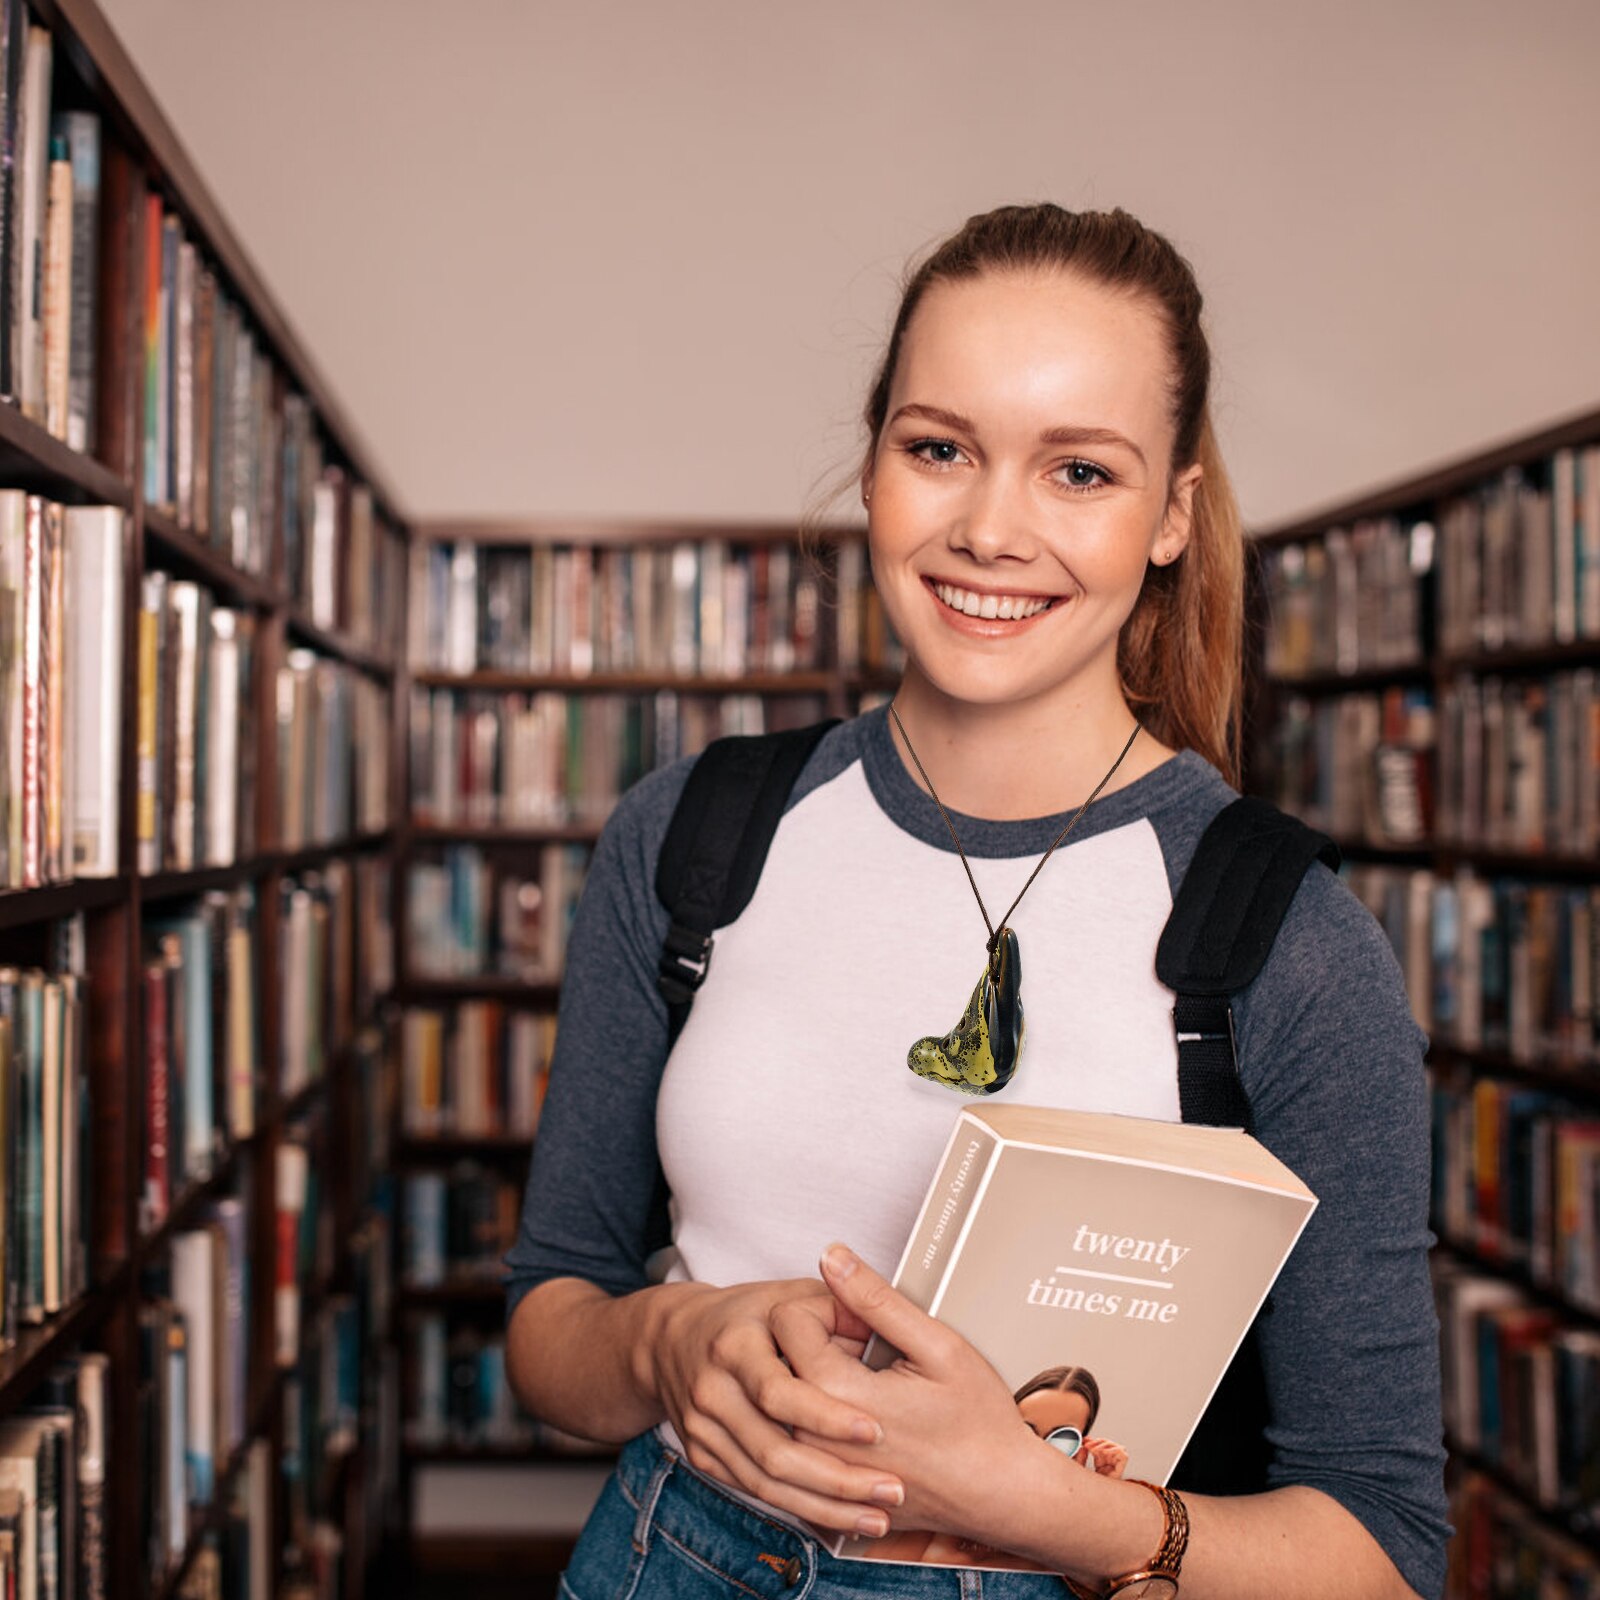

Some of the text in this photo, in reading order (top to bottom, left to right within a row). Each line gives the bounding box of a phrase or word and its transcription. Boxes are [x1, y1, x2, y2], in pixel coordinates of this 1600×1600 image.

[922, 1140, 980, 1270] twenty times me
[1072, 1224, 1191, 1273] twenty
[1027, 1276, 1178, 1323] times me
